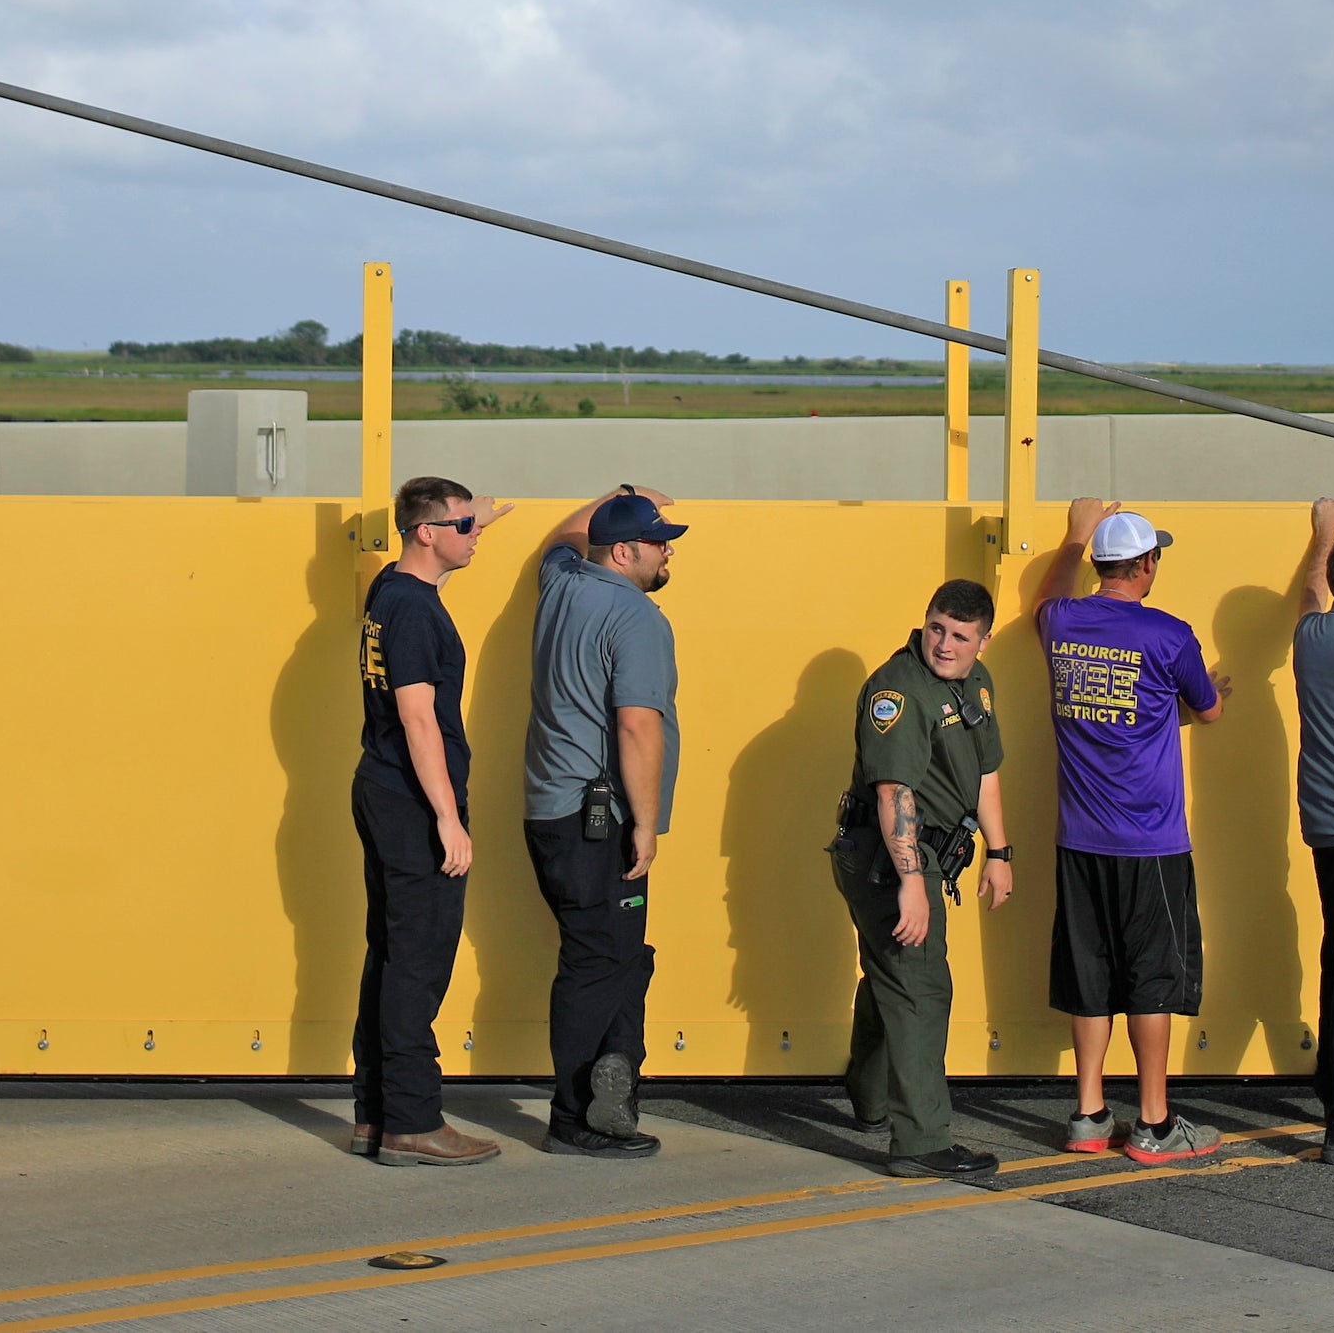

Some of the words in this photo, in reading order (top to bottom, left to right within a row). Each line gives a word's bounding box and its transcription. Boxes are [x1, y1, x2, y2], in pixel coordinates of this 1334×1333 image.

[1051, 641, 1142, 665] LAFOURCHE
[1051, 657, 1141, 709] FIRE
[1056, 703, 1120, 724] DISTRICT
[1125, 711, 1137, 726] 3
